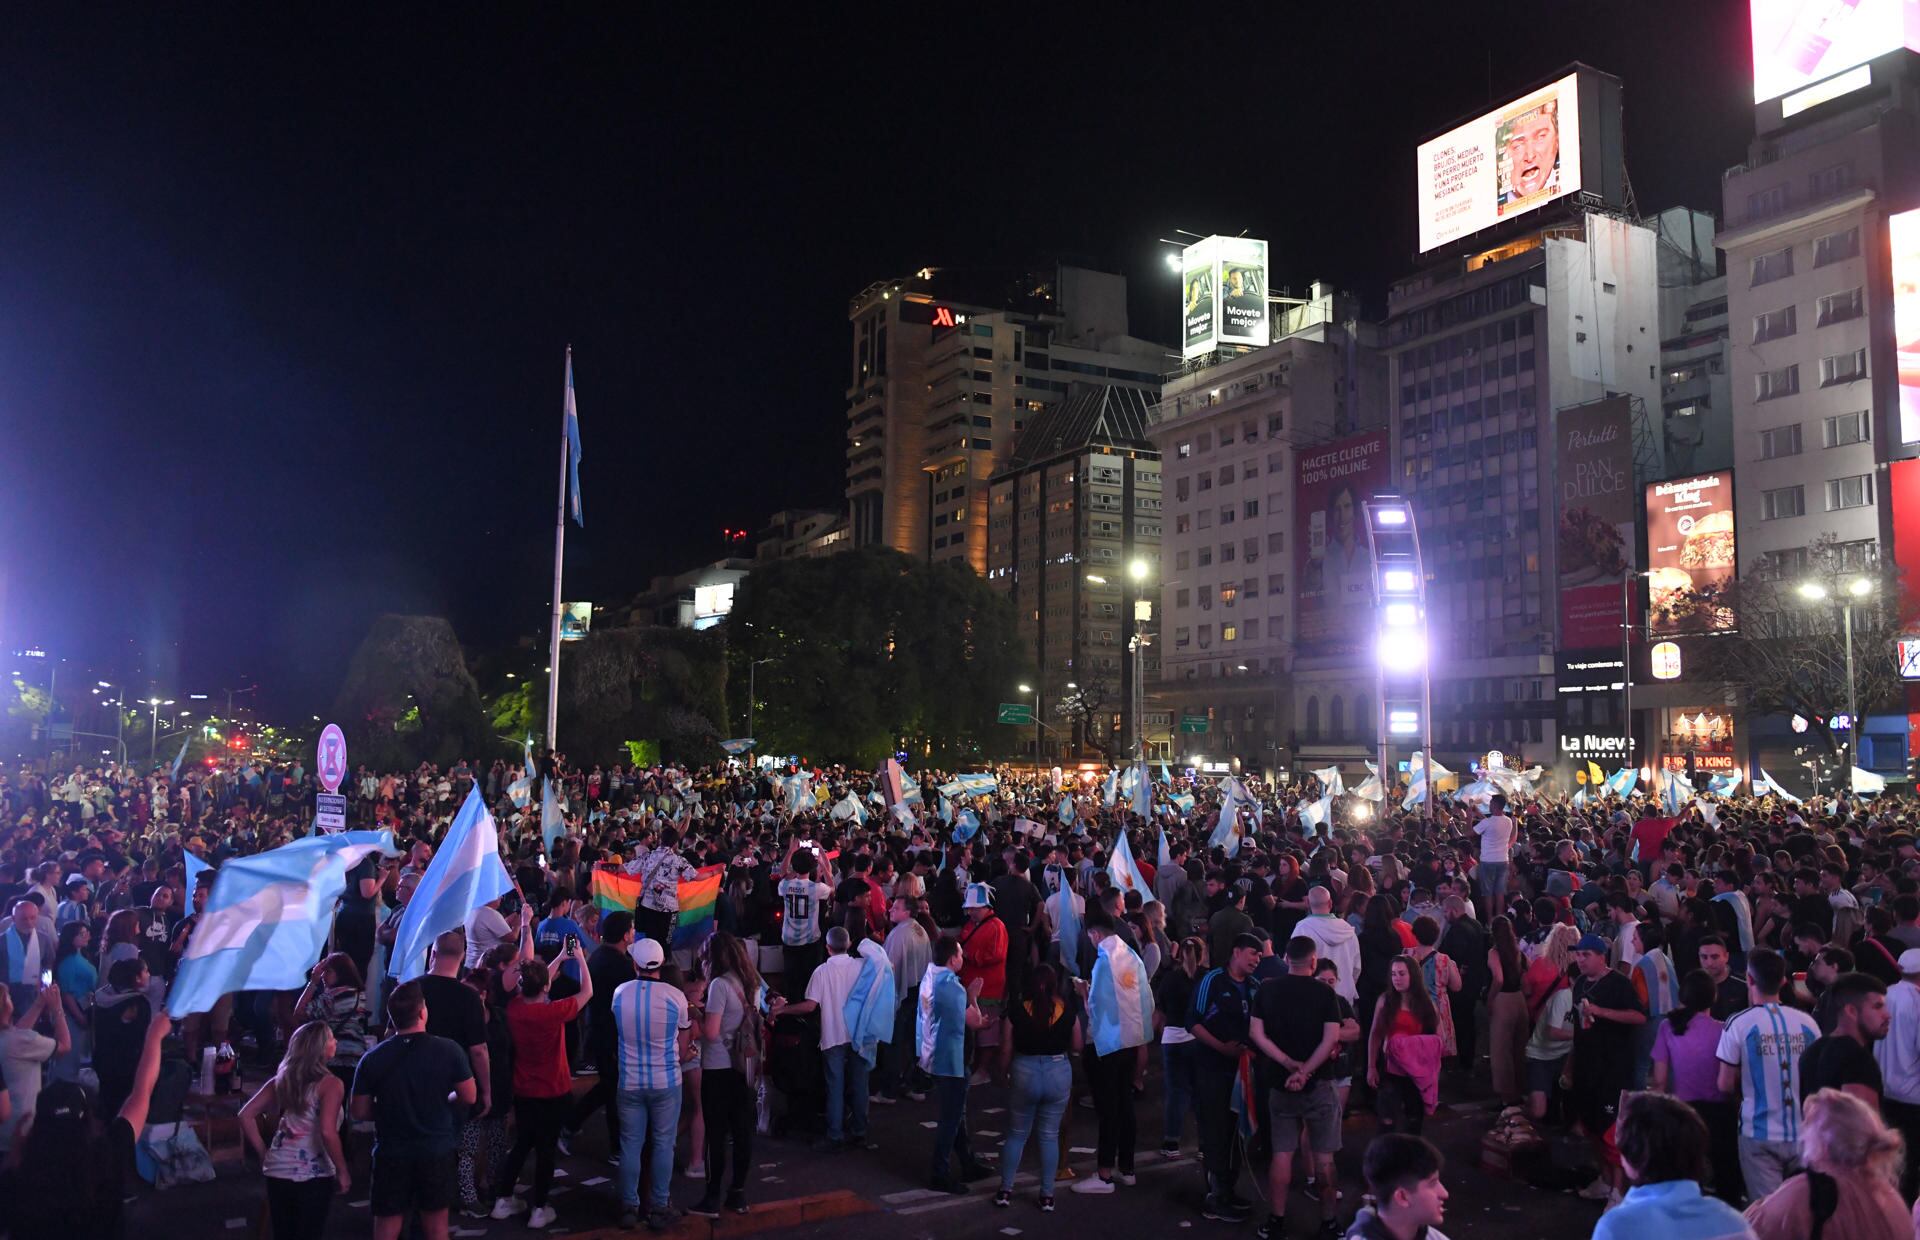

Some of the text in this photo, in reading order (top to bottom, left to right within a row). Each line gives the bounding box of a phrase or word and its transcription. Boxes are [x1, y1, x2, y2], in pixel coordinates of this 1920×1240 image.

[1443, 163, 1460, 177] PERRO
[1461, 152, 1484, 168] MUERTO
[1188, 312, 1211, 327] Movete
[1227, 306, 1261, 318] Movete
[1190, 322, 1208, 336] mejor
[1231, 317, 1257, 328] mejor
[1568, 425, 1618, 450] Pertutti
[1302, 441, 1380, 471] HACETE CLIENTE
[1302, 459, 1371, 485] 100% ONLINE.
[1577, 456, 1613, 479] PAN
[1564, 471, 1626, 500] DULCE
[1561, 734, 1580, 751] La
[1704, 756, 1732, 767] KING
[785, 894, 809, 919] 10
[1756, 1044, 1775, 1057] DEL
